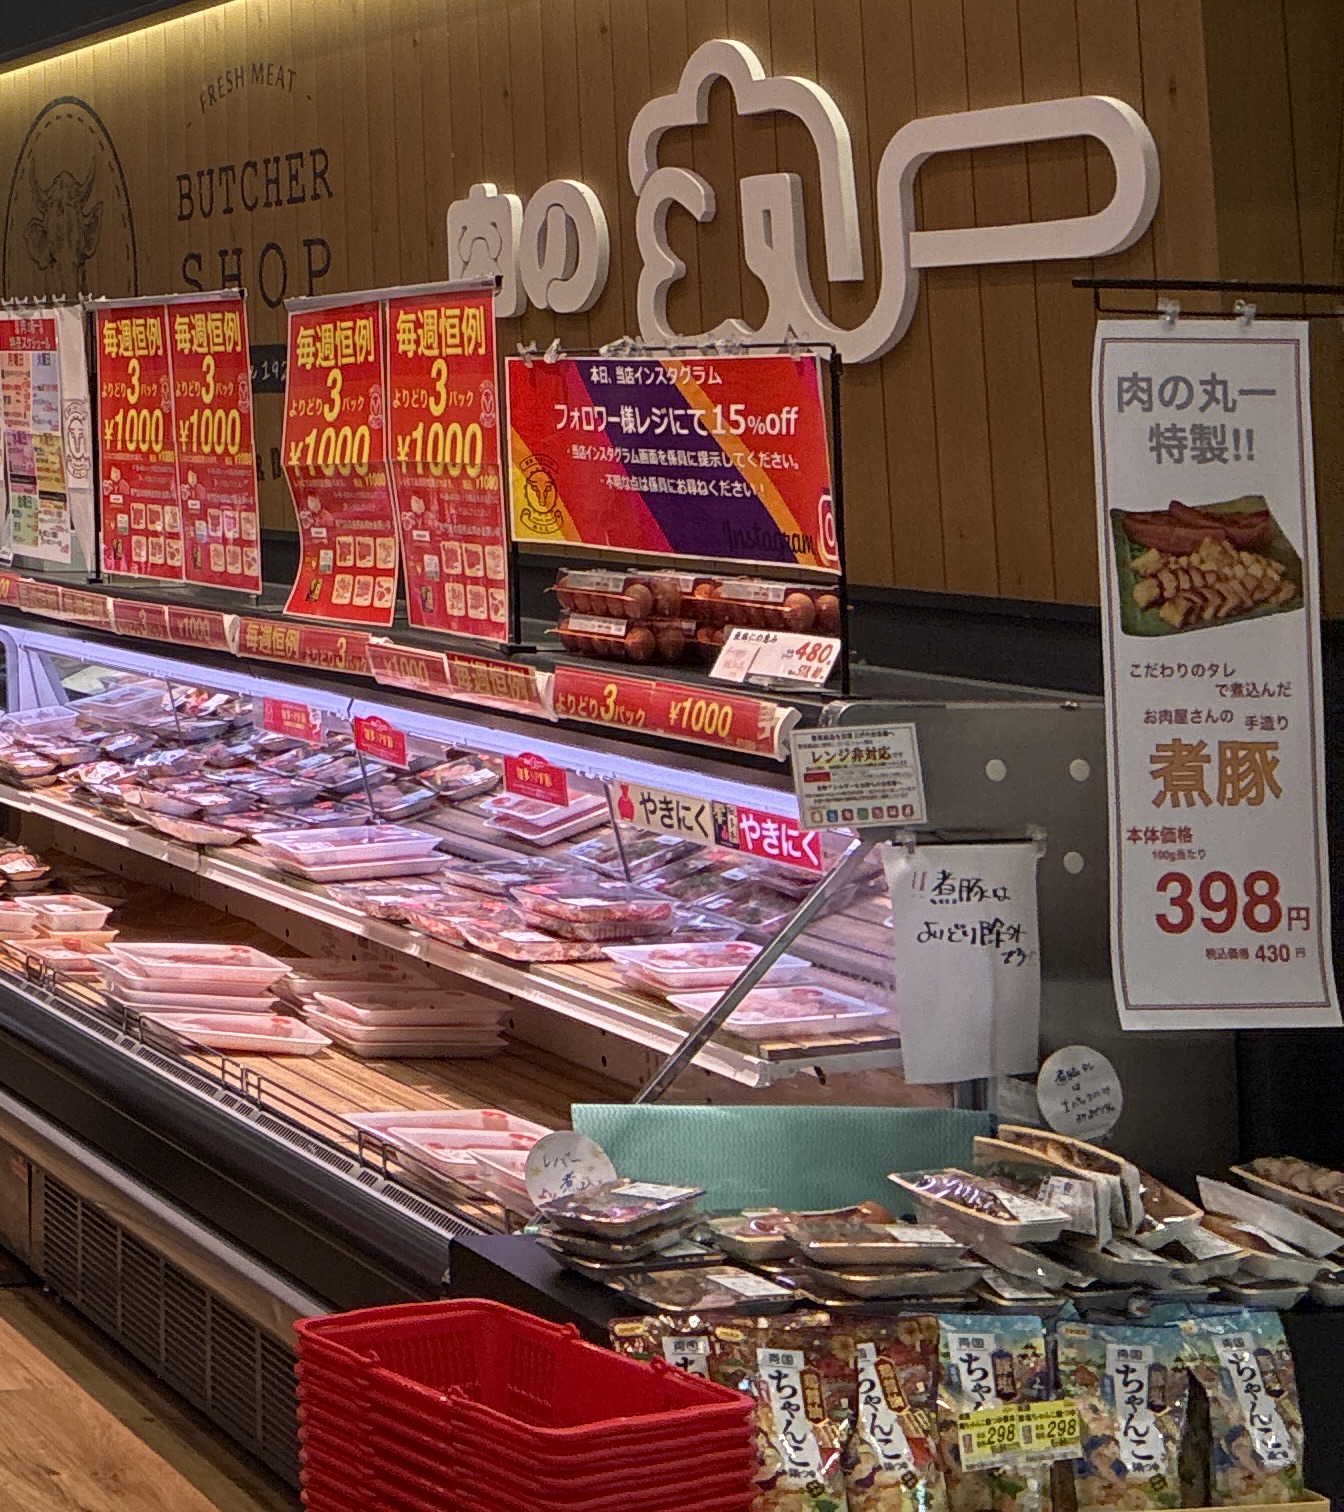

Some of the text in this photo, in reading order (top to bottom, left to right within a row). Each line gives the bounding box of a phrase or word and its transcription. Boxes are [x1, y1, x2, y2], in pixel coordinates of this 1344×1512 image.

[199, 62, 297, 114] FRESH MEAT
[176, 147, 333, 222] BUTCHER
[182, 238, 332, 308] SHOP
[104, 317, 163, 358] 毎週恒例
[175, 311, 242, 354] 毎週恒例
[296, 316, 375, 370] 毎週恒例
[396, 306, 487, 358] 毎週恒例
[590, 365, 722, 385] 本日、当店インスタグラム
[1117, 372, 1277, 413] 肉の丸一
[104, 408, 163, 453] ¥1000
[179, 409, 240, 454] ¥1000
[289, 425, 370, 477] ¥1000
[397, 422, 482, 478] ¥1000
[245, 624, 300, 660] 毎週恒例
[1129, 663, 1237, 679] こだわりのタレ
[1215, 683, 1292, 699] で煮込んだ
[668, 698, 732, 738] ¥1000
[1149, 737, 1283, 809] 煮豚
[639, 791, 819, 866] やきにく やきにく
[1126, 826, 1193, 844] 本体価格
[768, 1370, 810, 1467] ちゃんこ
[987, 1423, 1015, 1445] 298
[1047, 1418, 1077, 1439] 298
[1116, 1364, 1154, 1461] ちゃんこ
